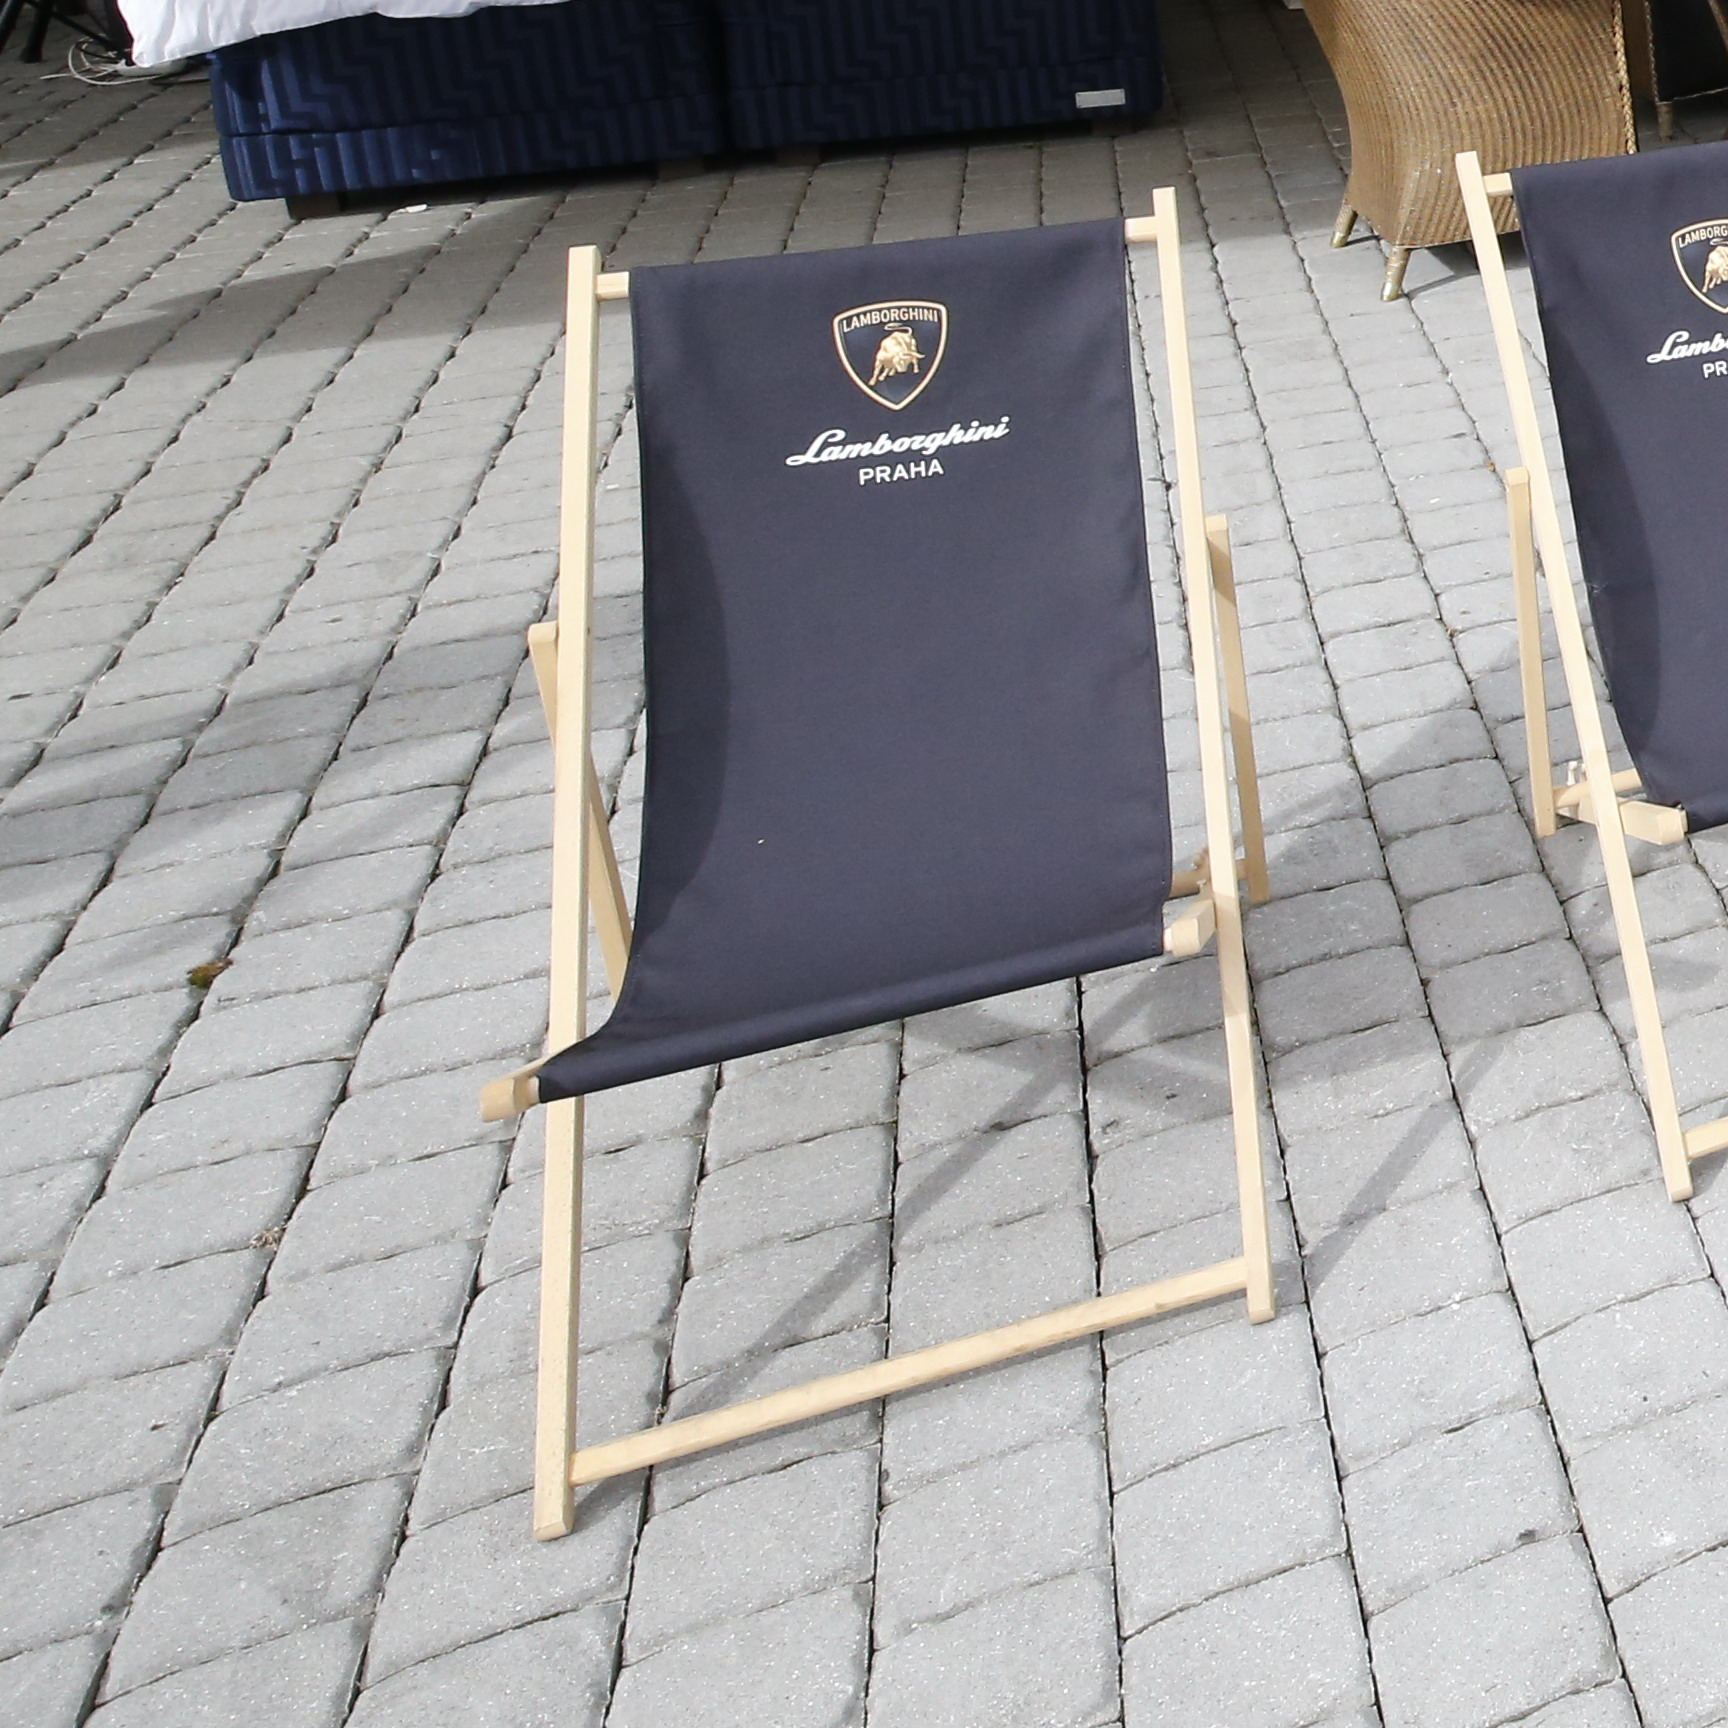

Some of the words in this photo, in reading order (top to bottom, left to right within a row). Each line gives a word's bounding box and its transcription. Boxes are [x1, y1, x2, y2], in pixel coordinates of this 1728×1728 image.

[842, 307, 938, 332] LAMBORGHINI
[785, 415, 1011, 467] Lamborghini
[858, 458, 944, 486] PRAHA
